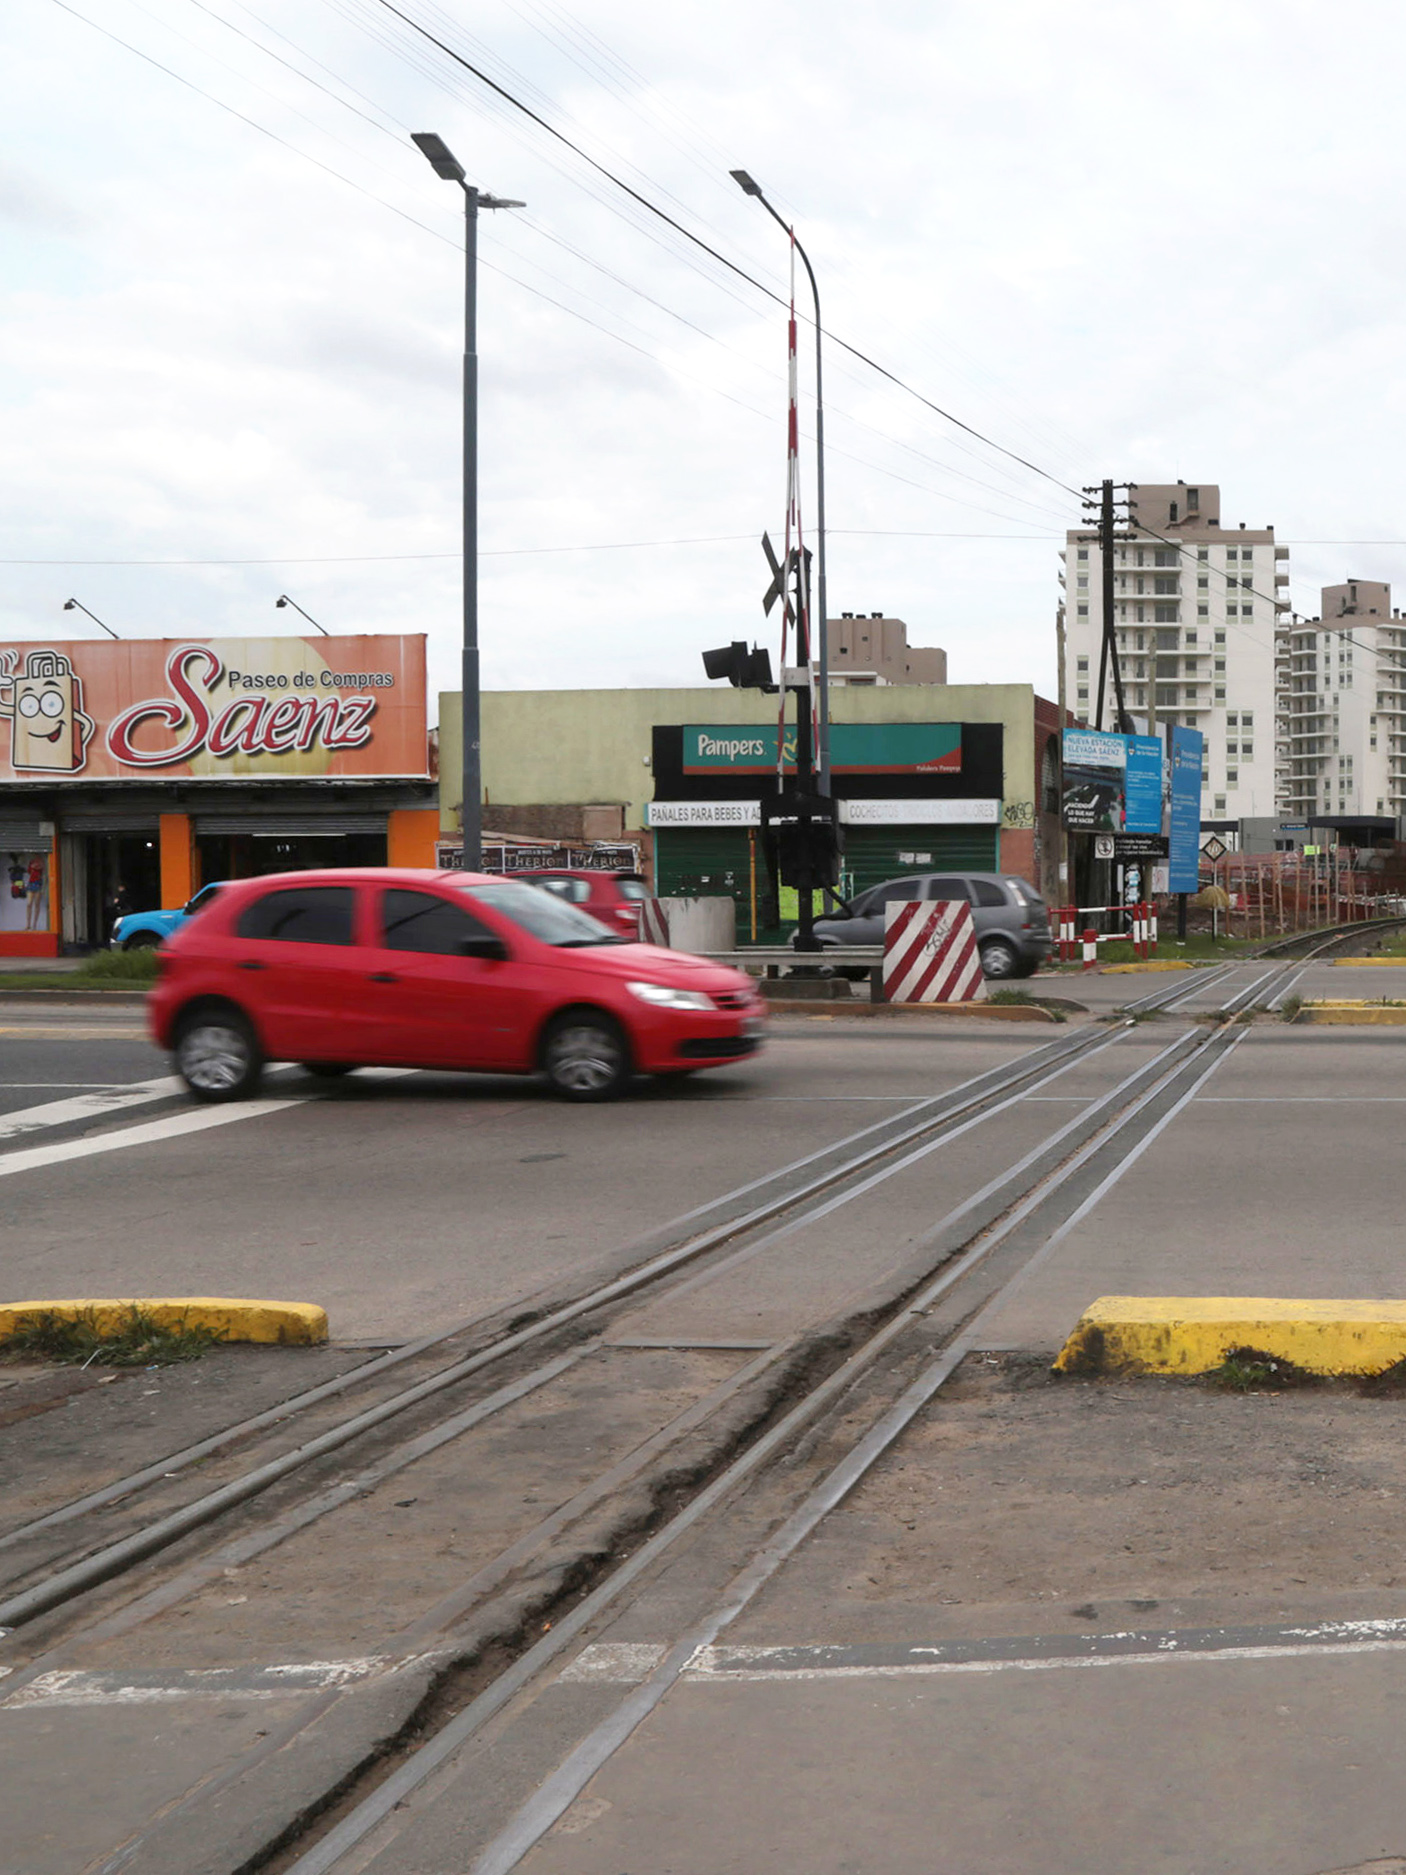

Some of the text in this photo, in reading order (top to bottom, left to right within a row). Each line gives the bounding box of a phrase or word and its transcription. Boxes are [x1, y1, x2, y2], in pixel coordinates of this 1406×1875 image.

[228, 670, 394, 690] Paseo de Compras
[107, 645, 376, 767] Saenz
[698, 734, 765, 759] Pampers
[651, 804, 689, 821] PAÑALES
[691, 807, 713, 821] PARA
[715, 806, 743, 820] BEBES
[744, 807, 750, 819] Y
